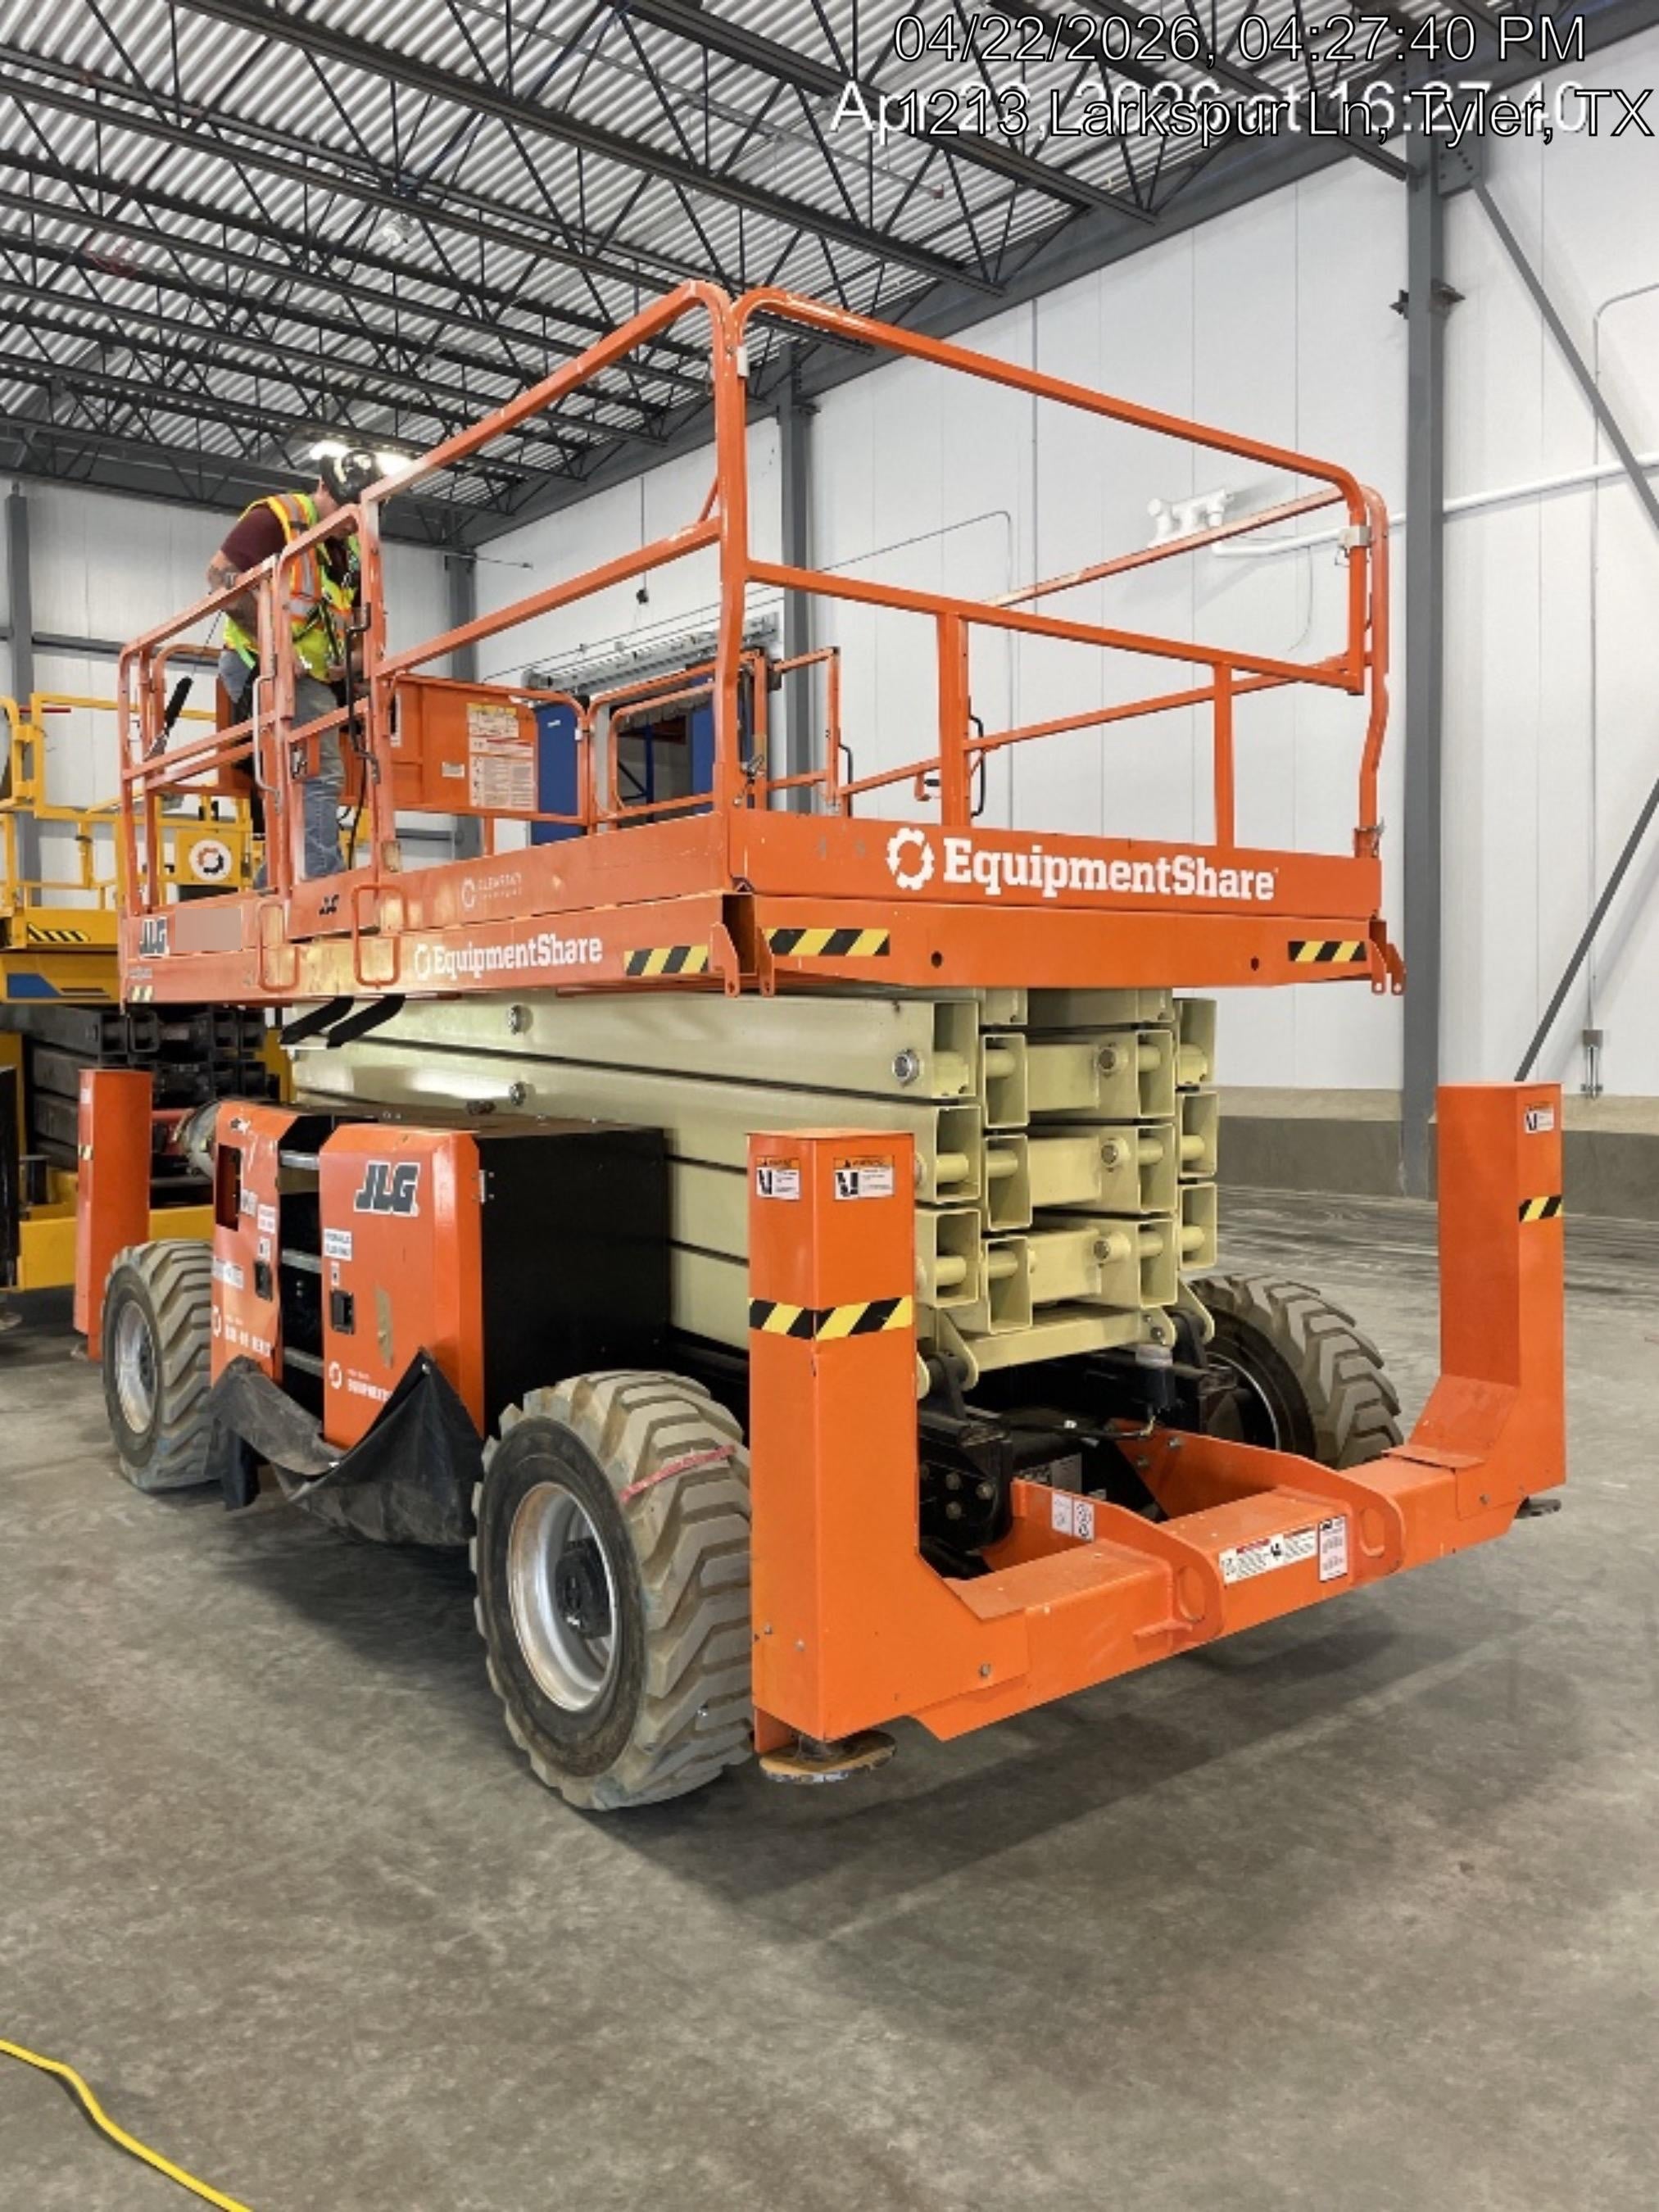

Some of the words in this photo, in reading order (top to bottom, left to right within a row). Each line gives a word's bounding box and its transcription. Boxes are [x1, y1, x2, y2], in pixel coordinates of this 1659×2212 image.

[943, 836, 1276, 900] EquipmentShare
[139, 916, 170, 961] JLG
[433, 932, 604, 981] EquipmentShare
[353, 1159, 420, 1218] JLG
